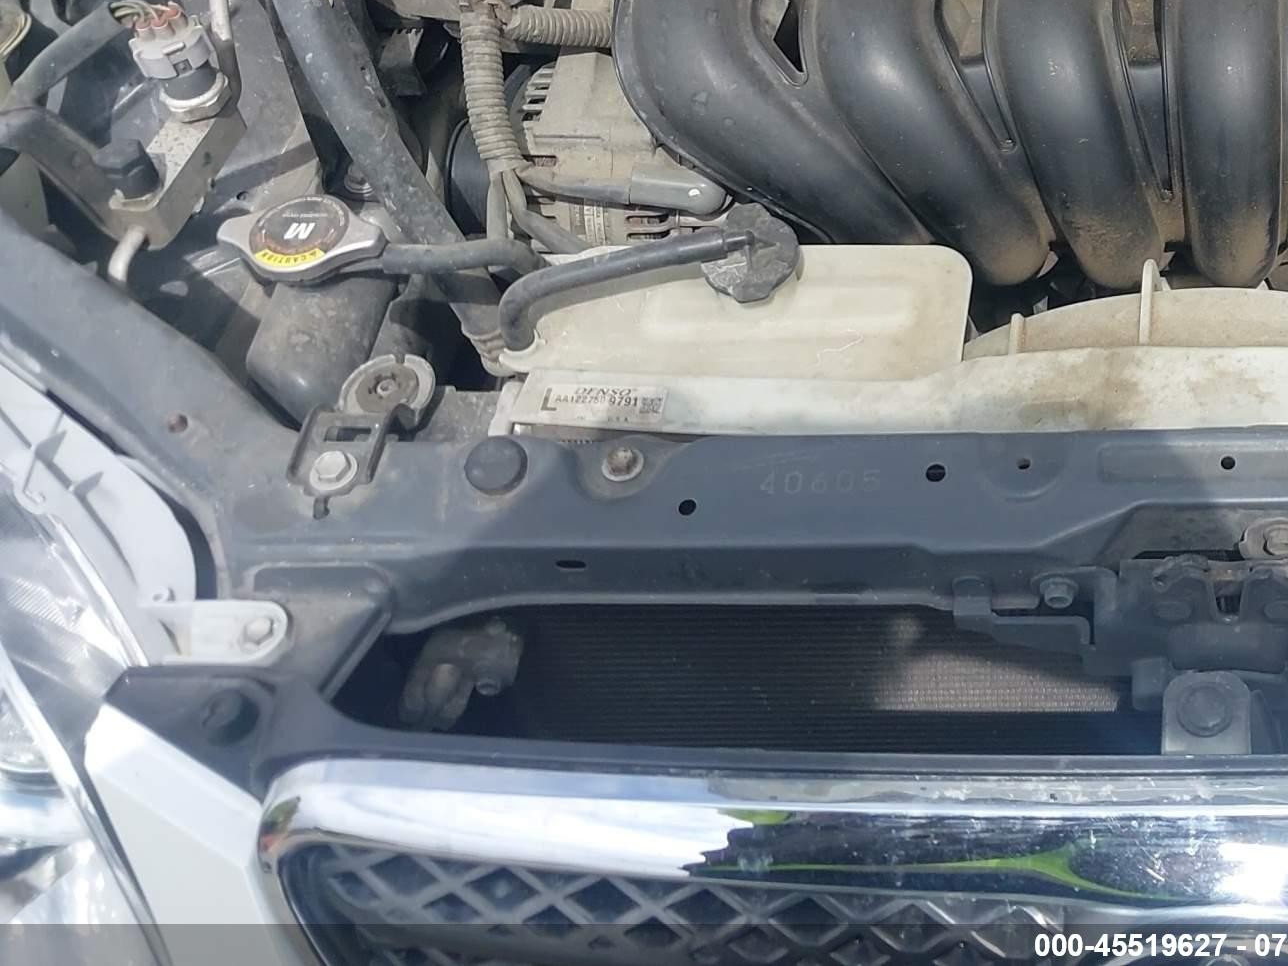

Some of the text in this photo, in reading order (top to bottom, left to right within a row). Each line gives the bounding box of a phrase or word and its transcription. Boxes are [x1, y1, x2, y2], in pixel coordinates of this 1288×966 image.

[261, 251, 308, 264] CAUTION
[574, 387, 633, 396] DENSO
[541, 387, 557, 412] L
